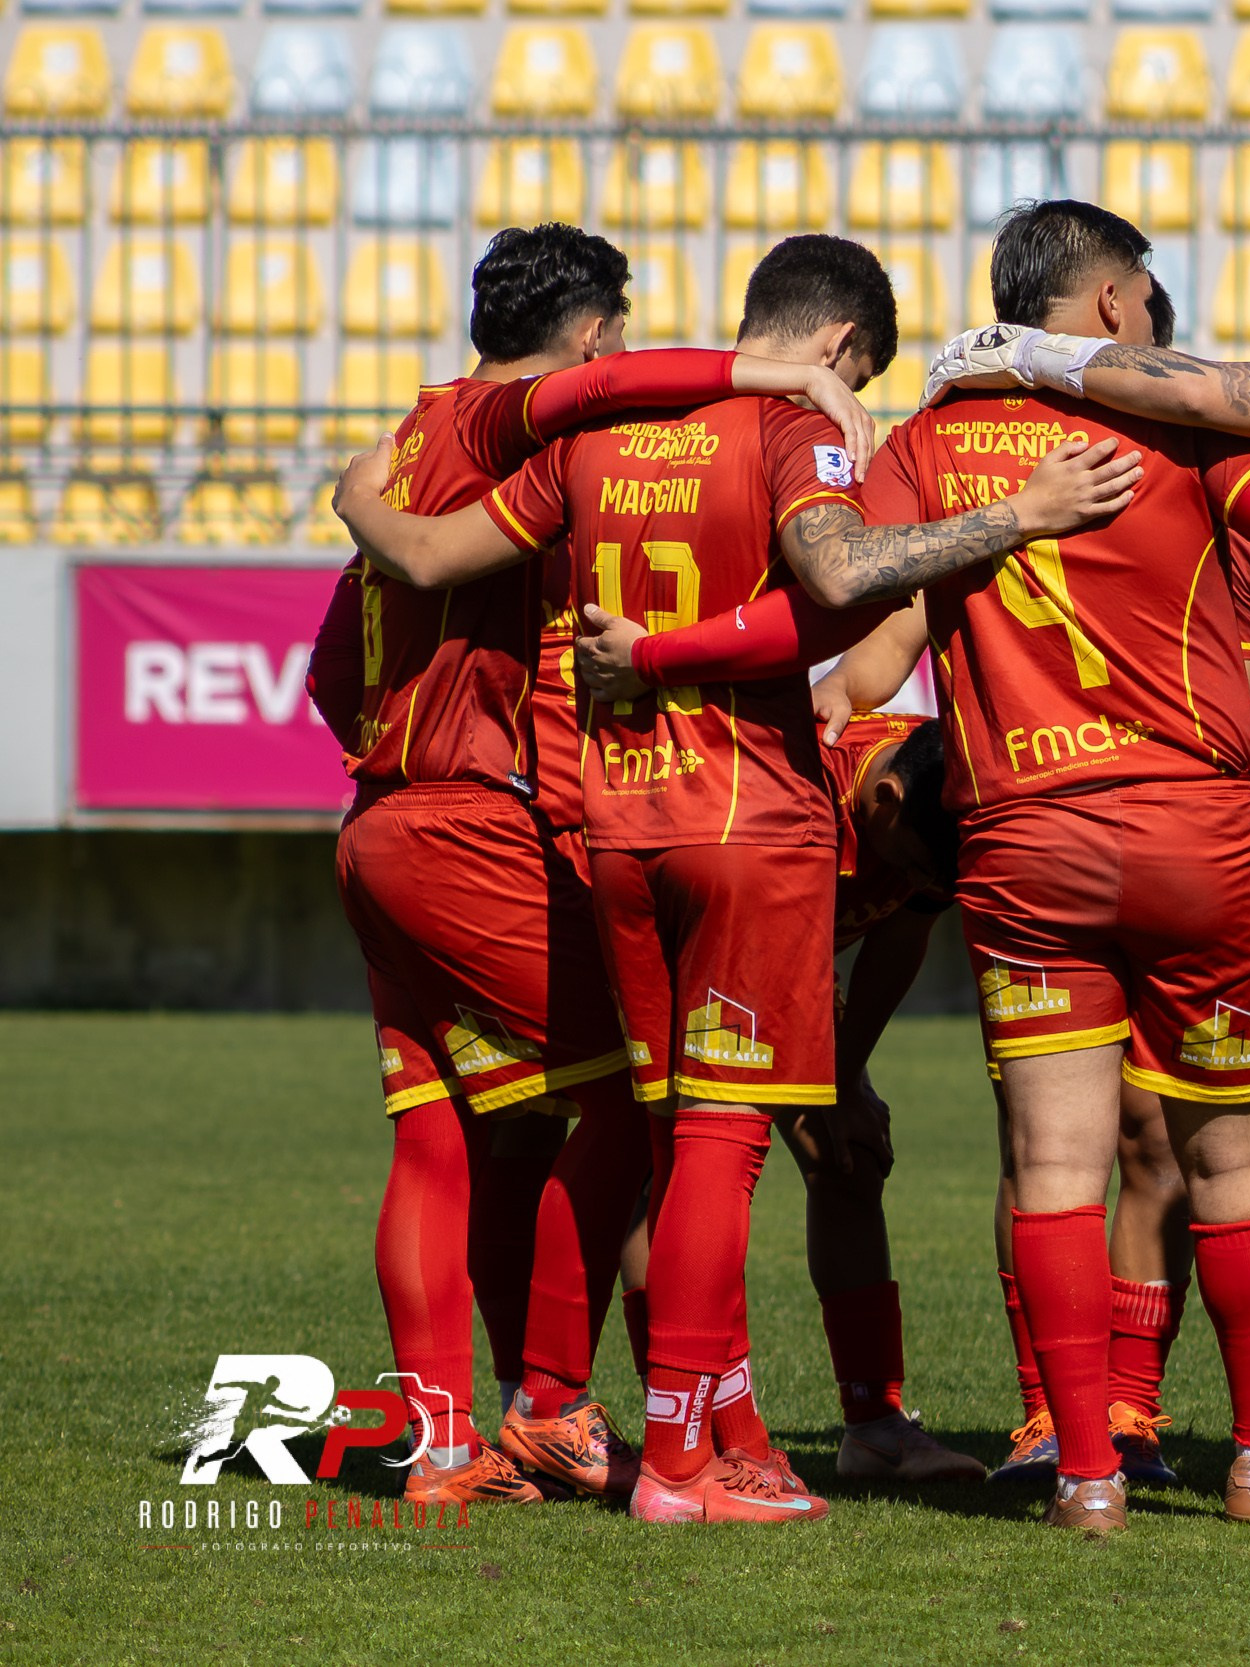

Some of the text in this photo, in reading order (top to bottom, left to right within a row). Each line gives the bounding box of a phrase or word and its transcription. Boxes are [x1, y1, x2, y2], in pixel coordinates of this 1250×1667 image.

[619, 434, 720, 461] JUANITO
[935, 421, 1064, 437] LIQUIDADORA
[599, 476, 702, 516] MAGGINI
[994, 537, 1112, 690] 4
[123, 640, 327, 725] REV
[1005, 714, 1117, 773] fmd
[1016, 754, 1120, 785] fisioterapia medicina deporte
